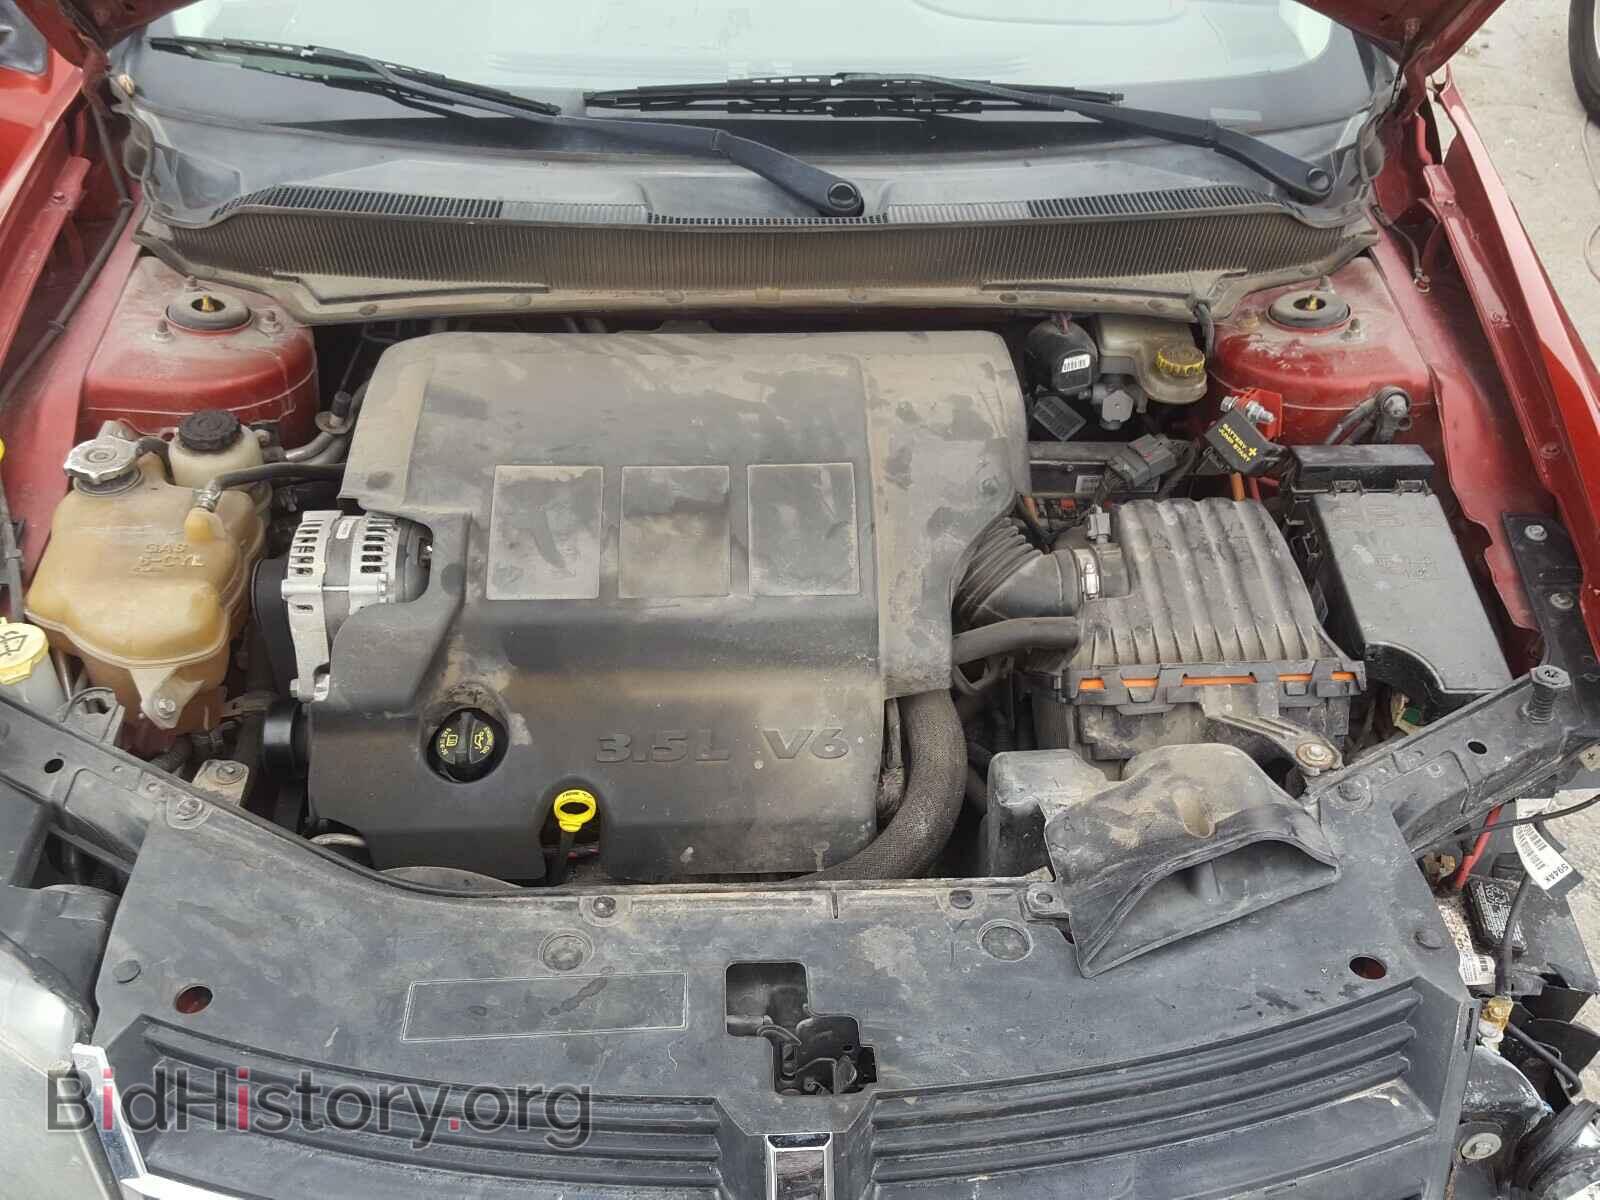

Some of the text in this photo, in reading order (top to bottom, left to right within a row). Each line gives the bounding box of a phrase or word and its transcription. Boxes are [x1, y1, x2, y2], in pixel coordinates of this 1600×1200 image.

[1218, 428, 1251, 463] JUMP START
[1222, 423, 1248, 449] BATTERY
[594, 727, 851, 764] 3.5L V6
